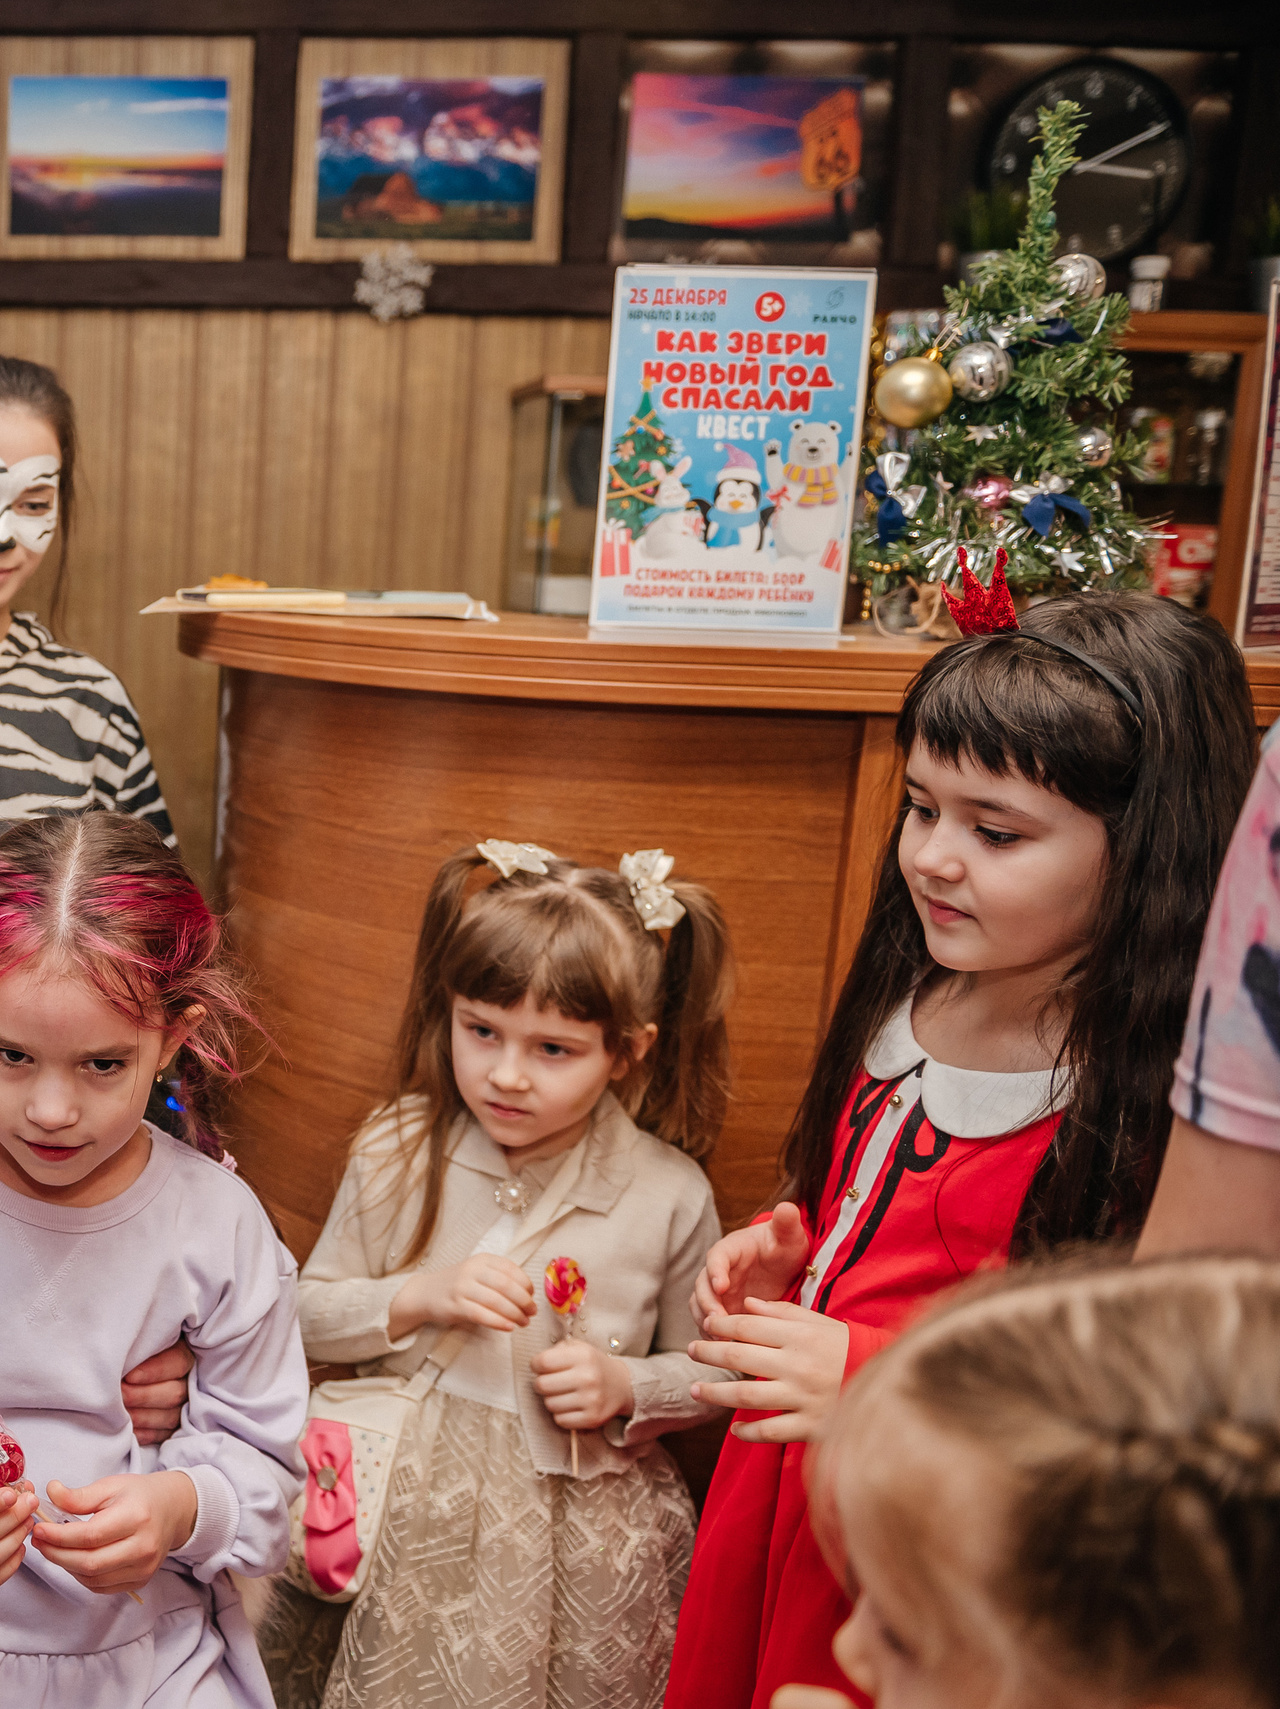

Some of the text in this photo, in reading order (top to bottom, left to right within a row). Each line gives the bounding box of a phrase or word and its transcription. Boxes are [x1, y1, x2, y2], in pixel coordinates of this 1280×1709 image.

[629, 287, 728, 306] 25 ДЕКАБРЯ
[761, 296, 783, 317] 5+
[627, 309, 717, 322] НАЧАЛО В 14:00
[813, 314, 858, 324] РАНЧО
[656, 330, 827, 356] КАК ЗВЕРИ
[642, 356, 834, 388] НОВЫЙ ГОД
[662, 387, 812, 412] СПАСАЛИ
[696, 414, 770, 440] КВЕСТ
[635, 568, 712, 583] СТОИМОСТЬ
[623, 584, 684, 599] ПОДАРОК
[687, 586, 755, 601] КАЖДОМУ
